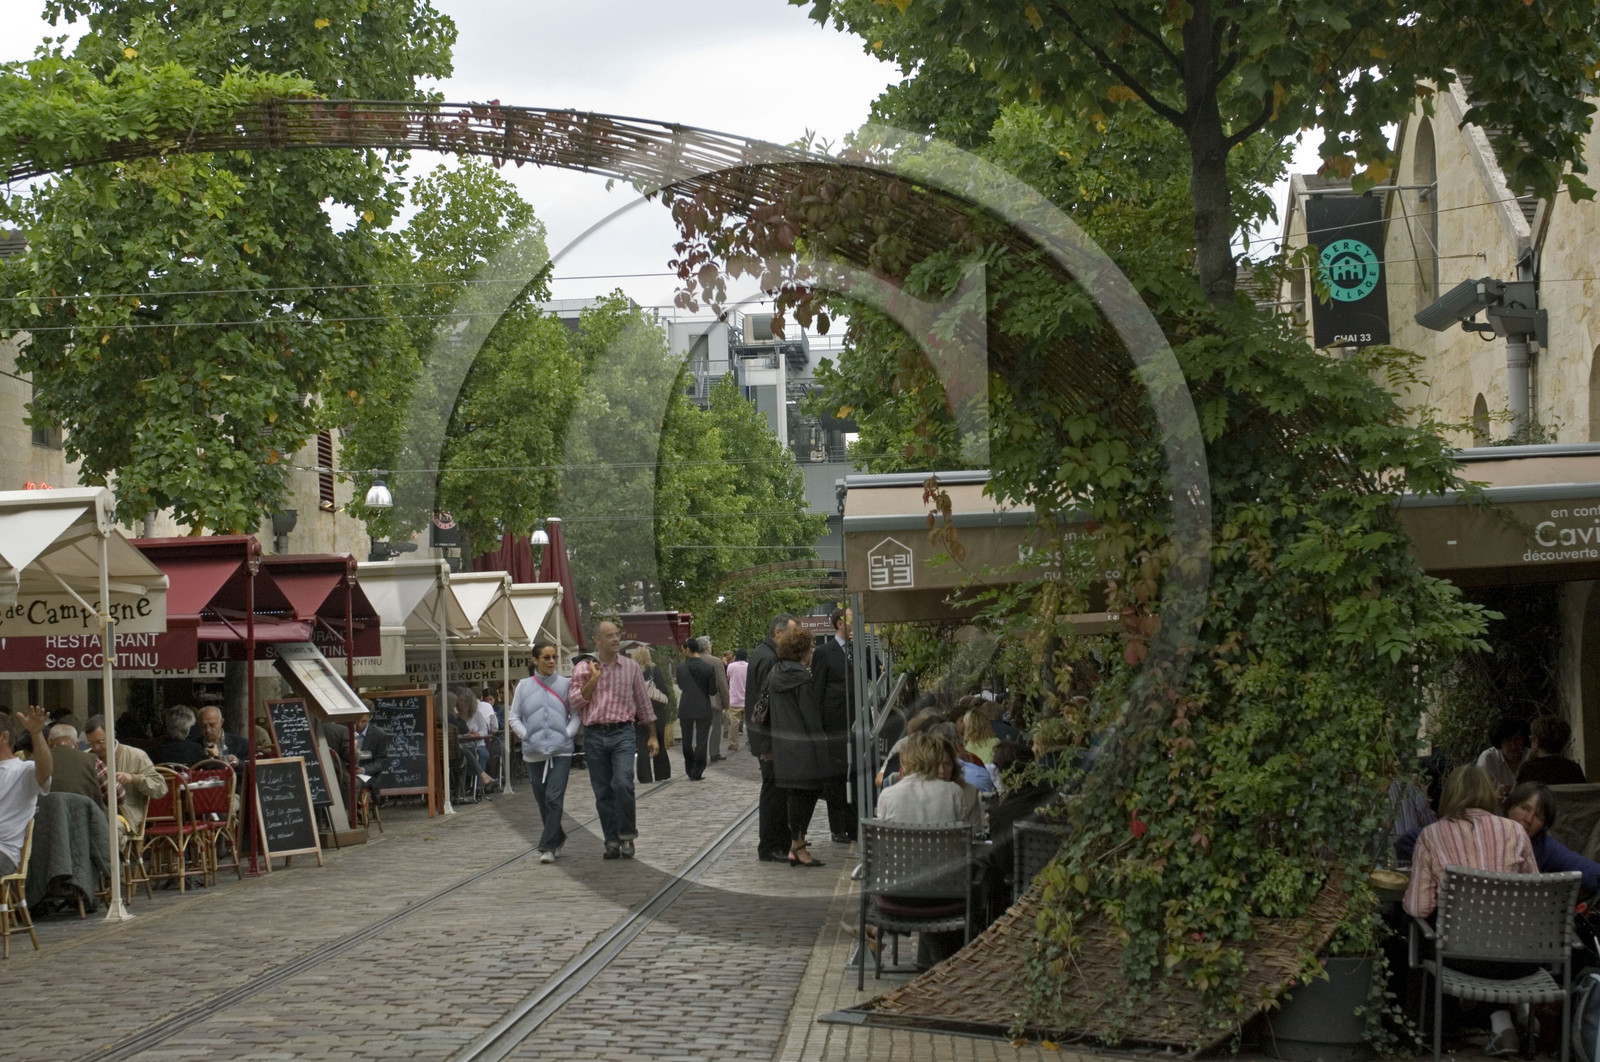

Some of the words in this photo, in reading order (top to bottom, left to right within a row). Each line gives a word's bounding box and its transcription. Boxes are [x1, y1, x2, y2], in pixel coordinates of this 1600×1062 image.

[1323, 242, 1372, 260] BERCY
[1322, 271, 1376, 299] VLLAGE
[1360, 333, 1372, 342] 33
[1550, 509, 1568, 518] en
[1522, 547, 1598, 561] découverte
[872, 567, 911, 585] 33
[5, 604, 25, 619] de
[46, 633, 160, 648] RESTARANT
[45, 654, 76, 668] Sce
[463, 660, 486, 670] DES
[409, 671, 497, 683] FLAMEKUCHE
